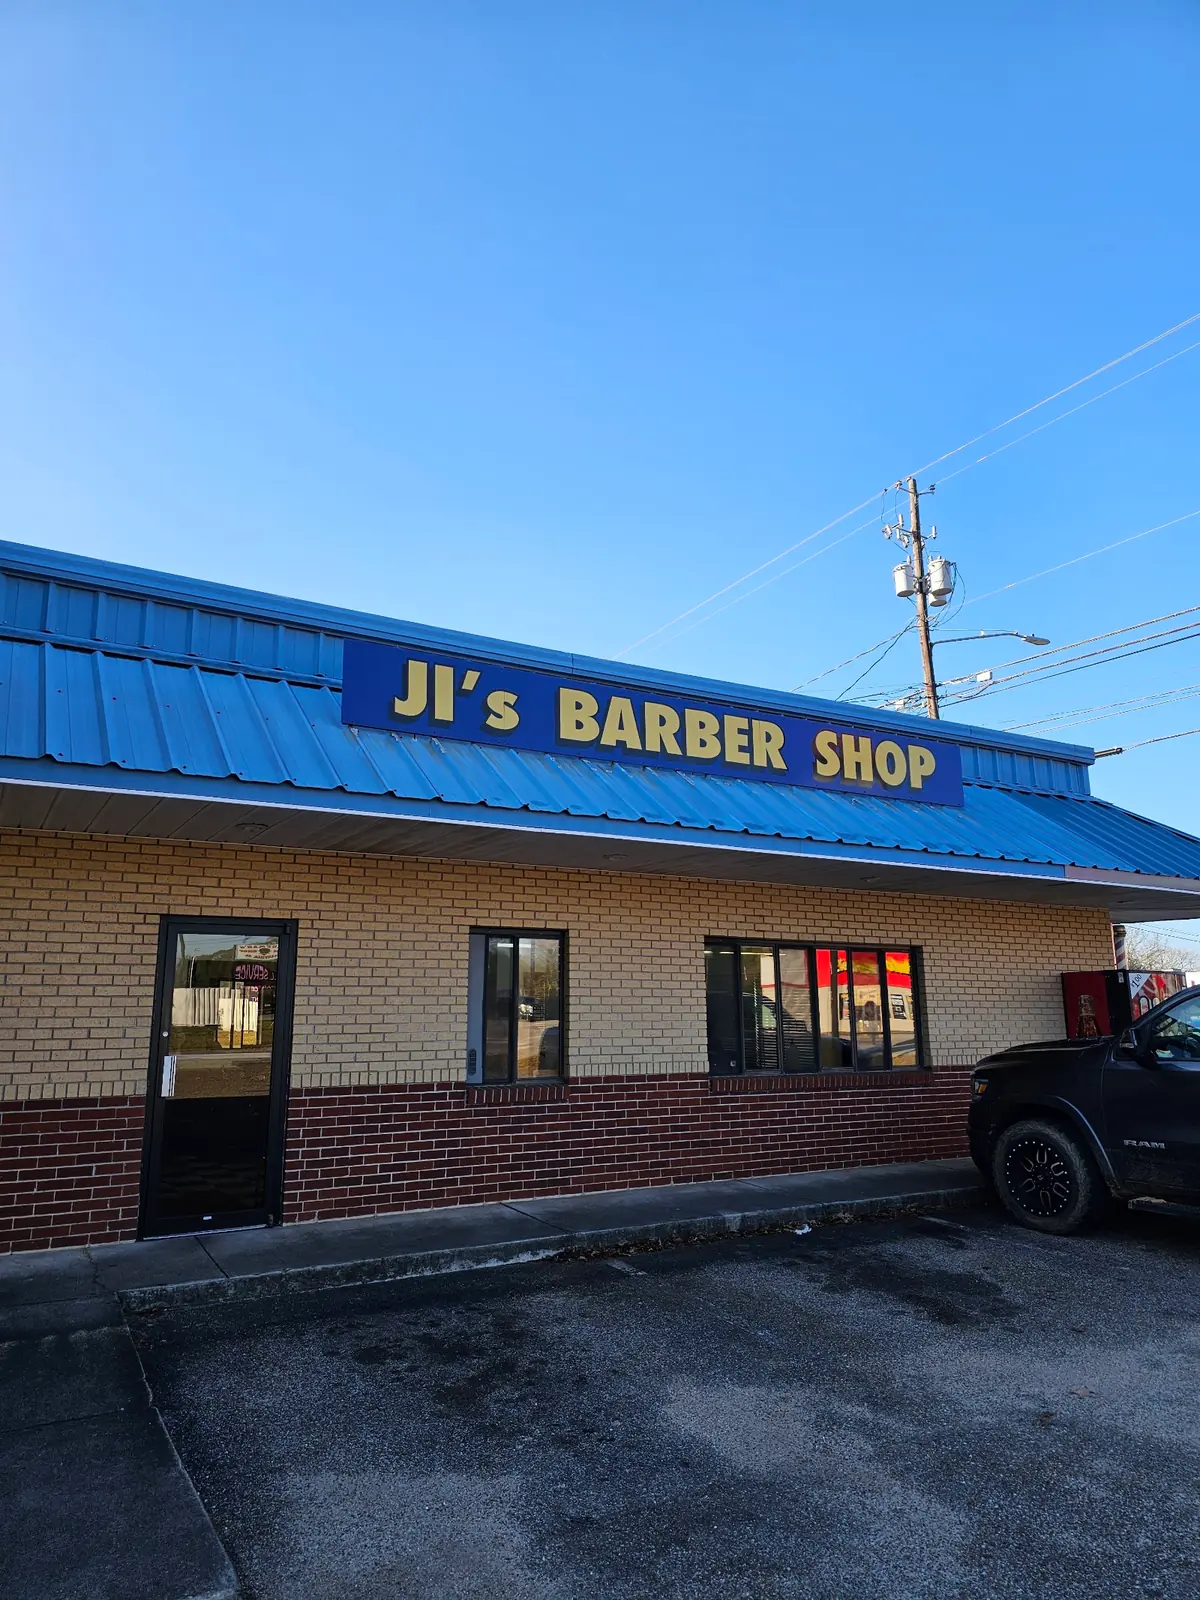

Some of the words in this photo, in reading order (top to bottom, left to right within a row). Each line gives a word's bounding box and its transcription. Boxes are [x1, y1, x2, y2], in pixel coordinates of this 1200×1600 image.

[559, 687, 787, 770] BARBER
[814, 730, 936, 789] SHOP
[1123, 1139, 1166, 1149] RAM
